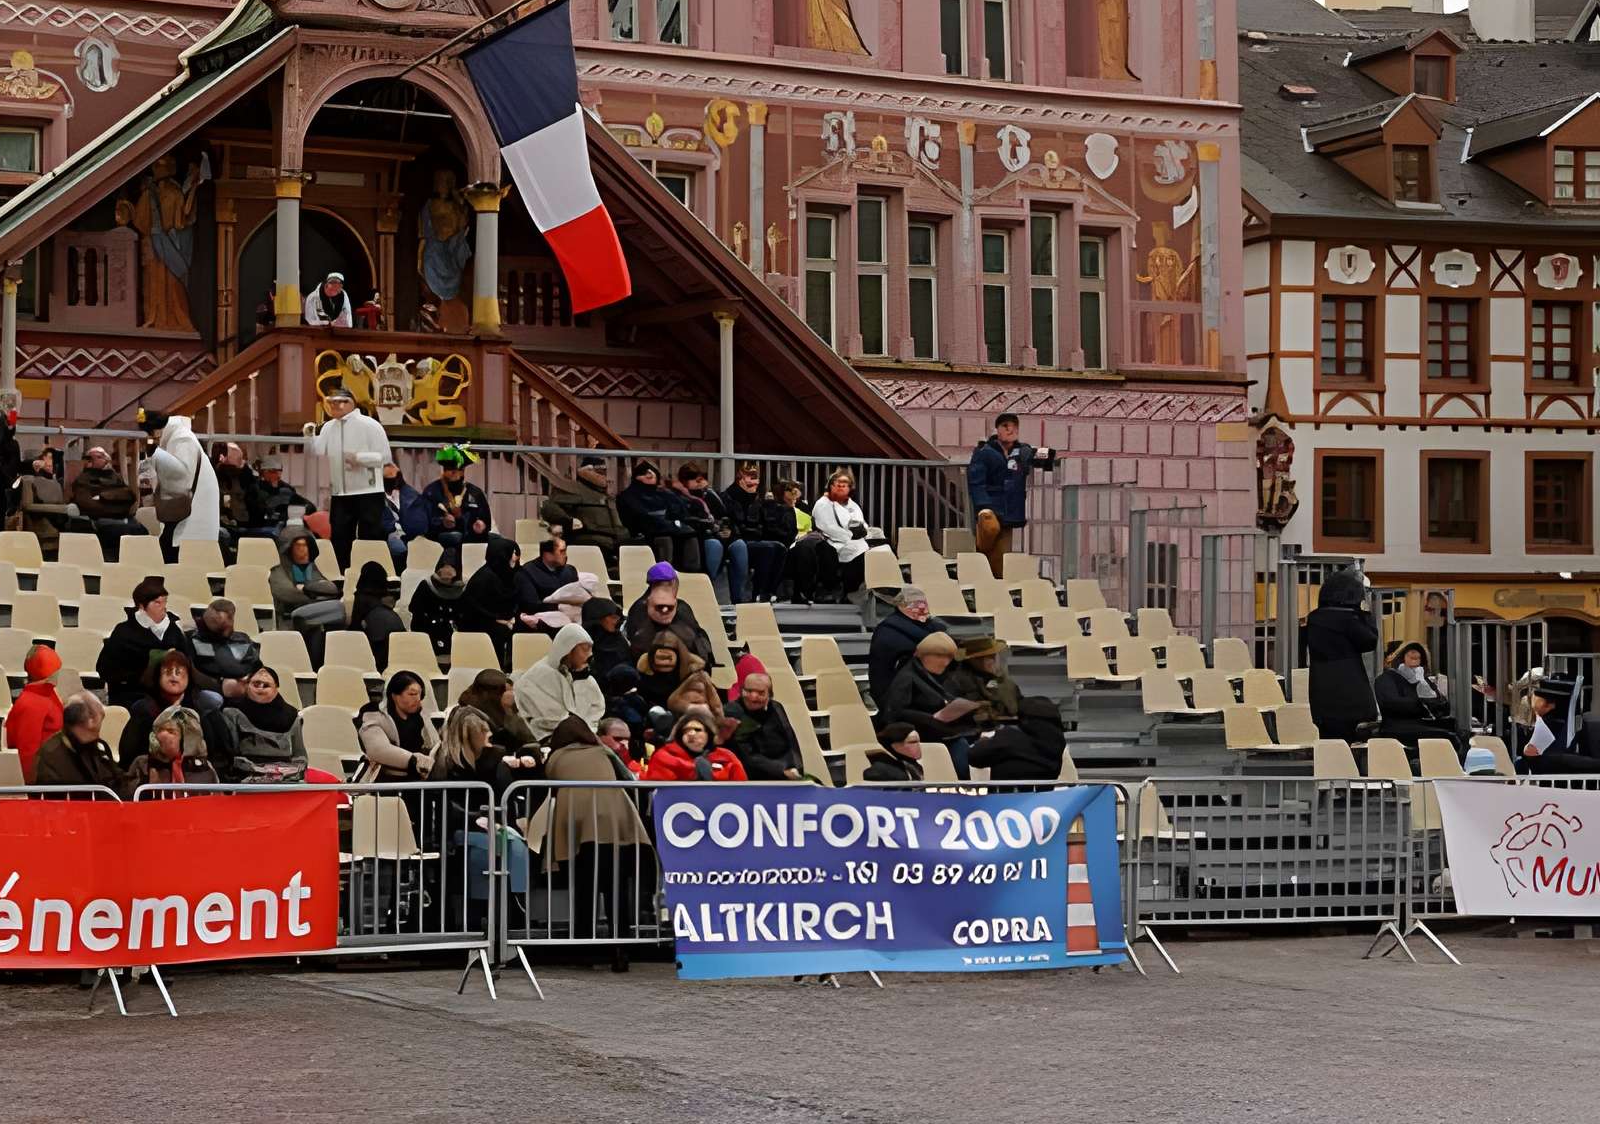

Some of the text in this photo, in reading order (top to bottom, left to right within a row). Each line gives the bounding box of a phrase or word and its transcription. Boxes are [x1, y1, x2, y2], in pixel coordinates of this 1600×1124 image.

[662, 802, 920, 849] CONFORT
[893, 863, 924, 885] 03
[673, 901, 896, 943] ALTKIRCH
[952, 916, 1054, 946] COPRA
